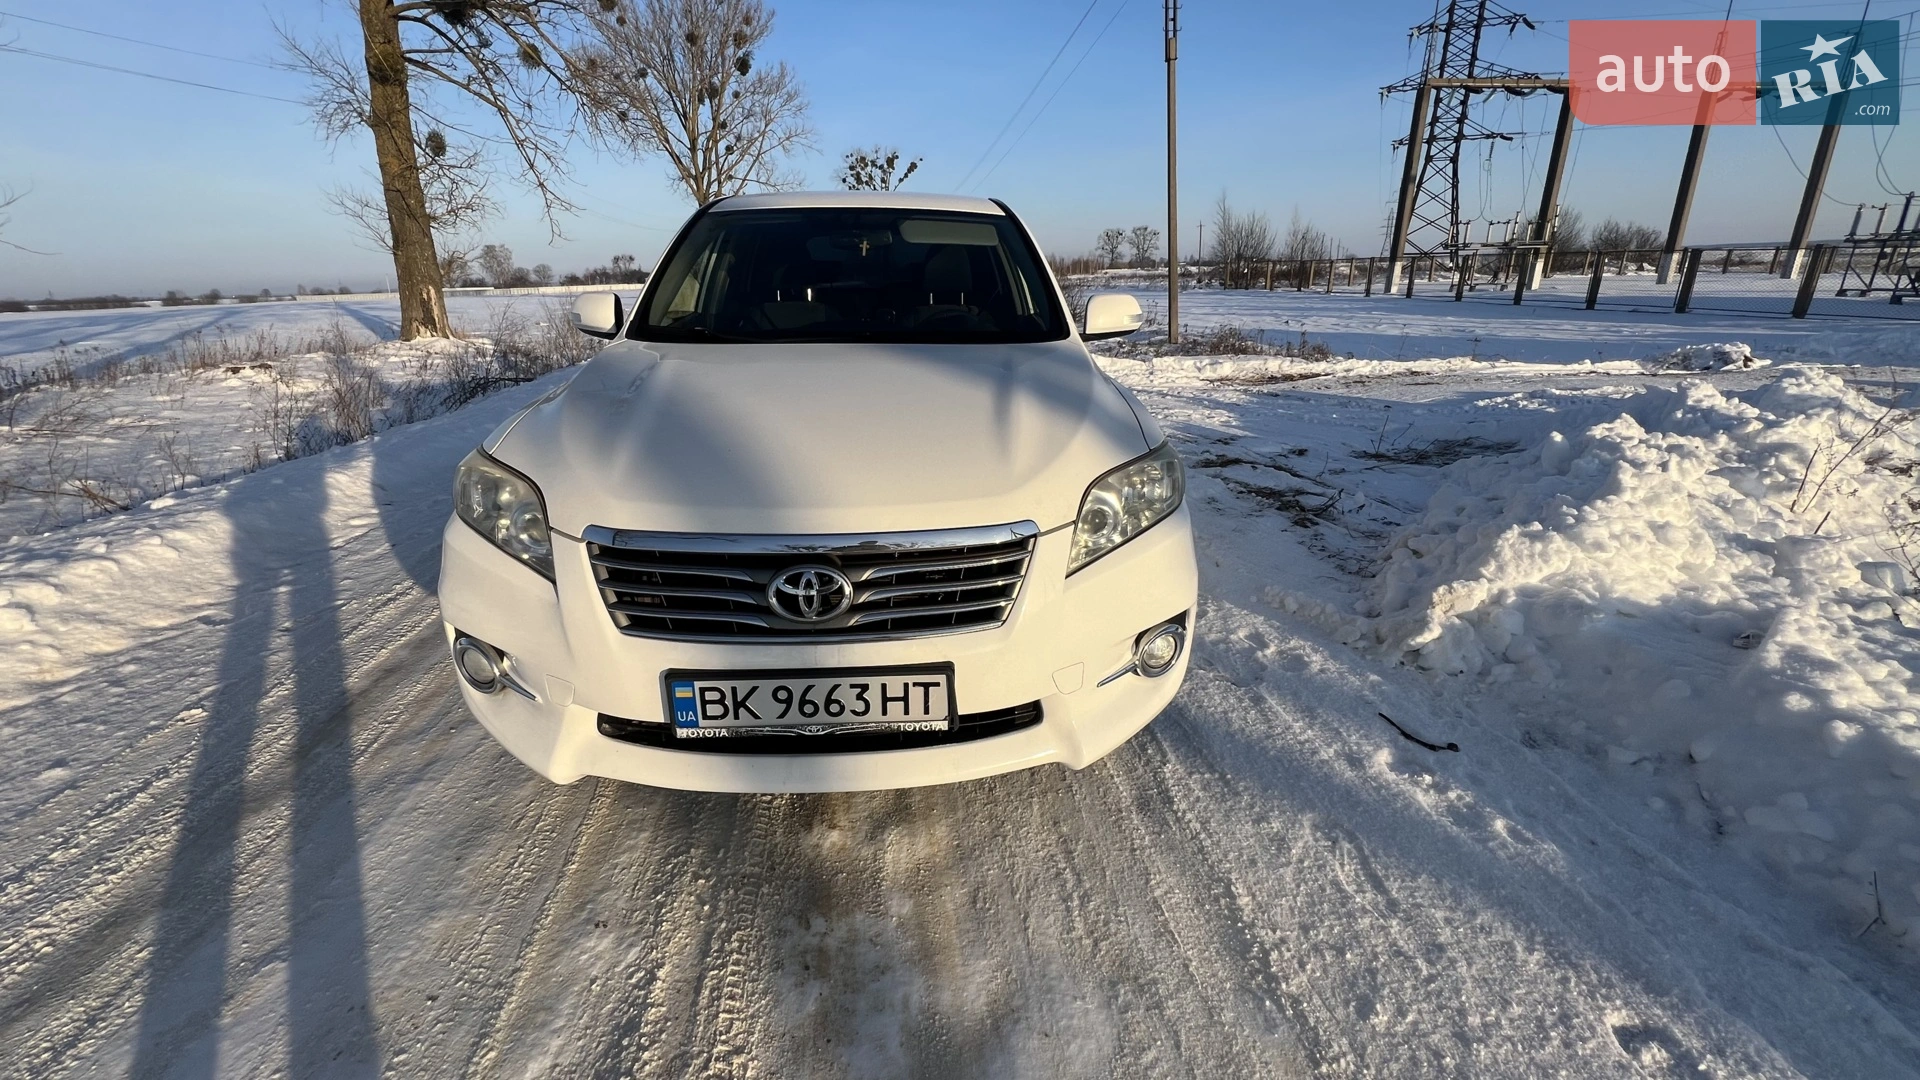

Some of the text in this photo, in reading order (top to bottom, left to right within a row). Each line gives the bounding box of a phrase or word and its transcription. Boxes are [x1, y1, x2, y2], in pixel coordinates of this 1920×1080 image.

[698, 681, 941, 721] BK 9663 HT
[677, 711, 697, 722] UA
[899, 722, 944, 732] TOYOTA
[683, 728, 729, 738] TOYOTA
